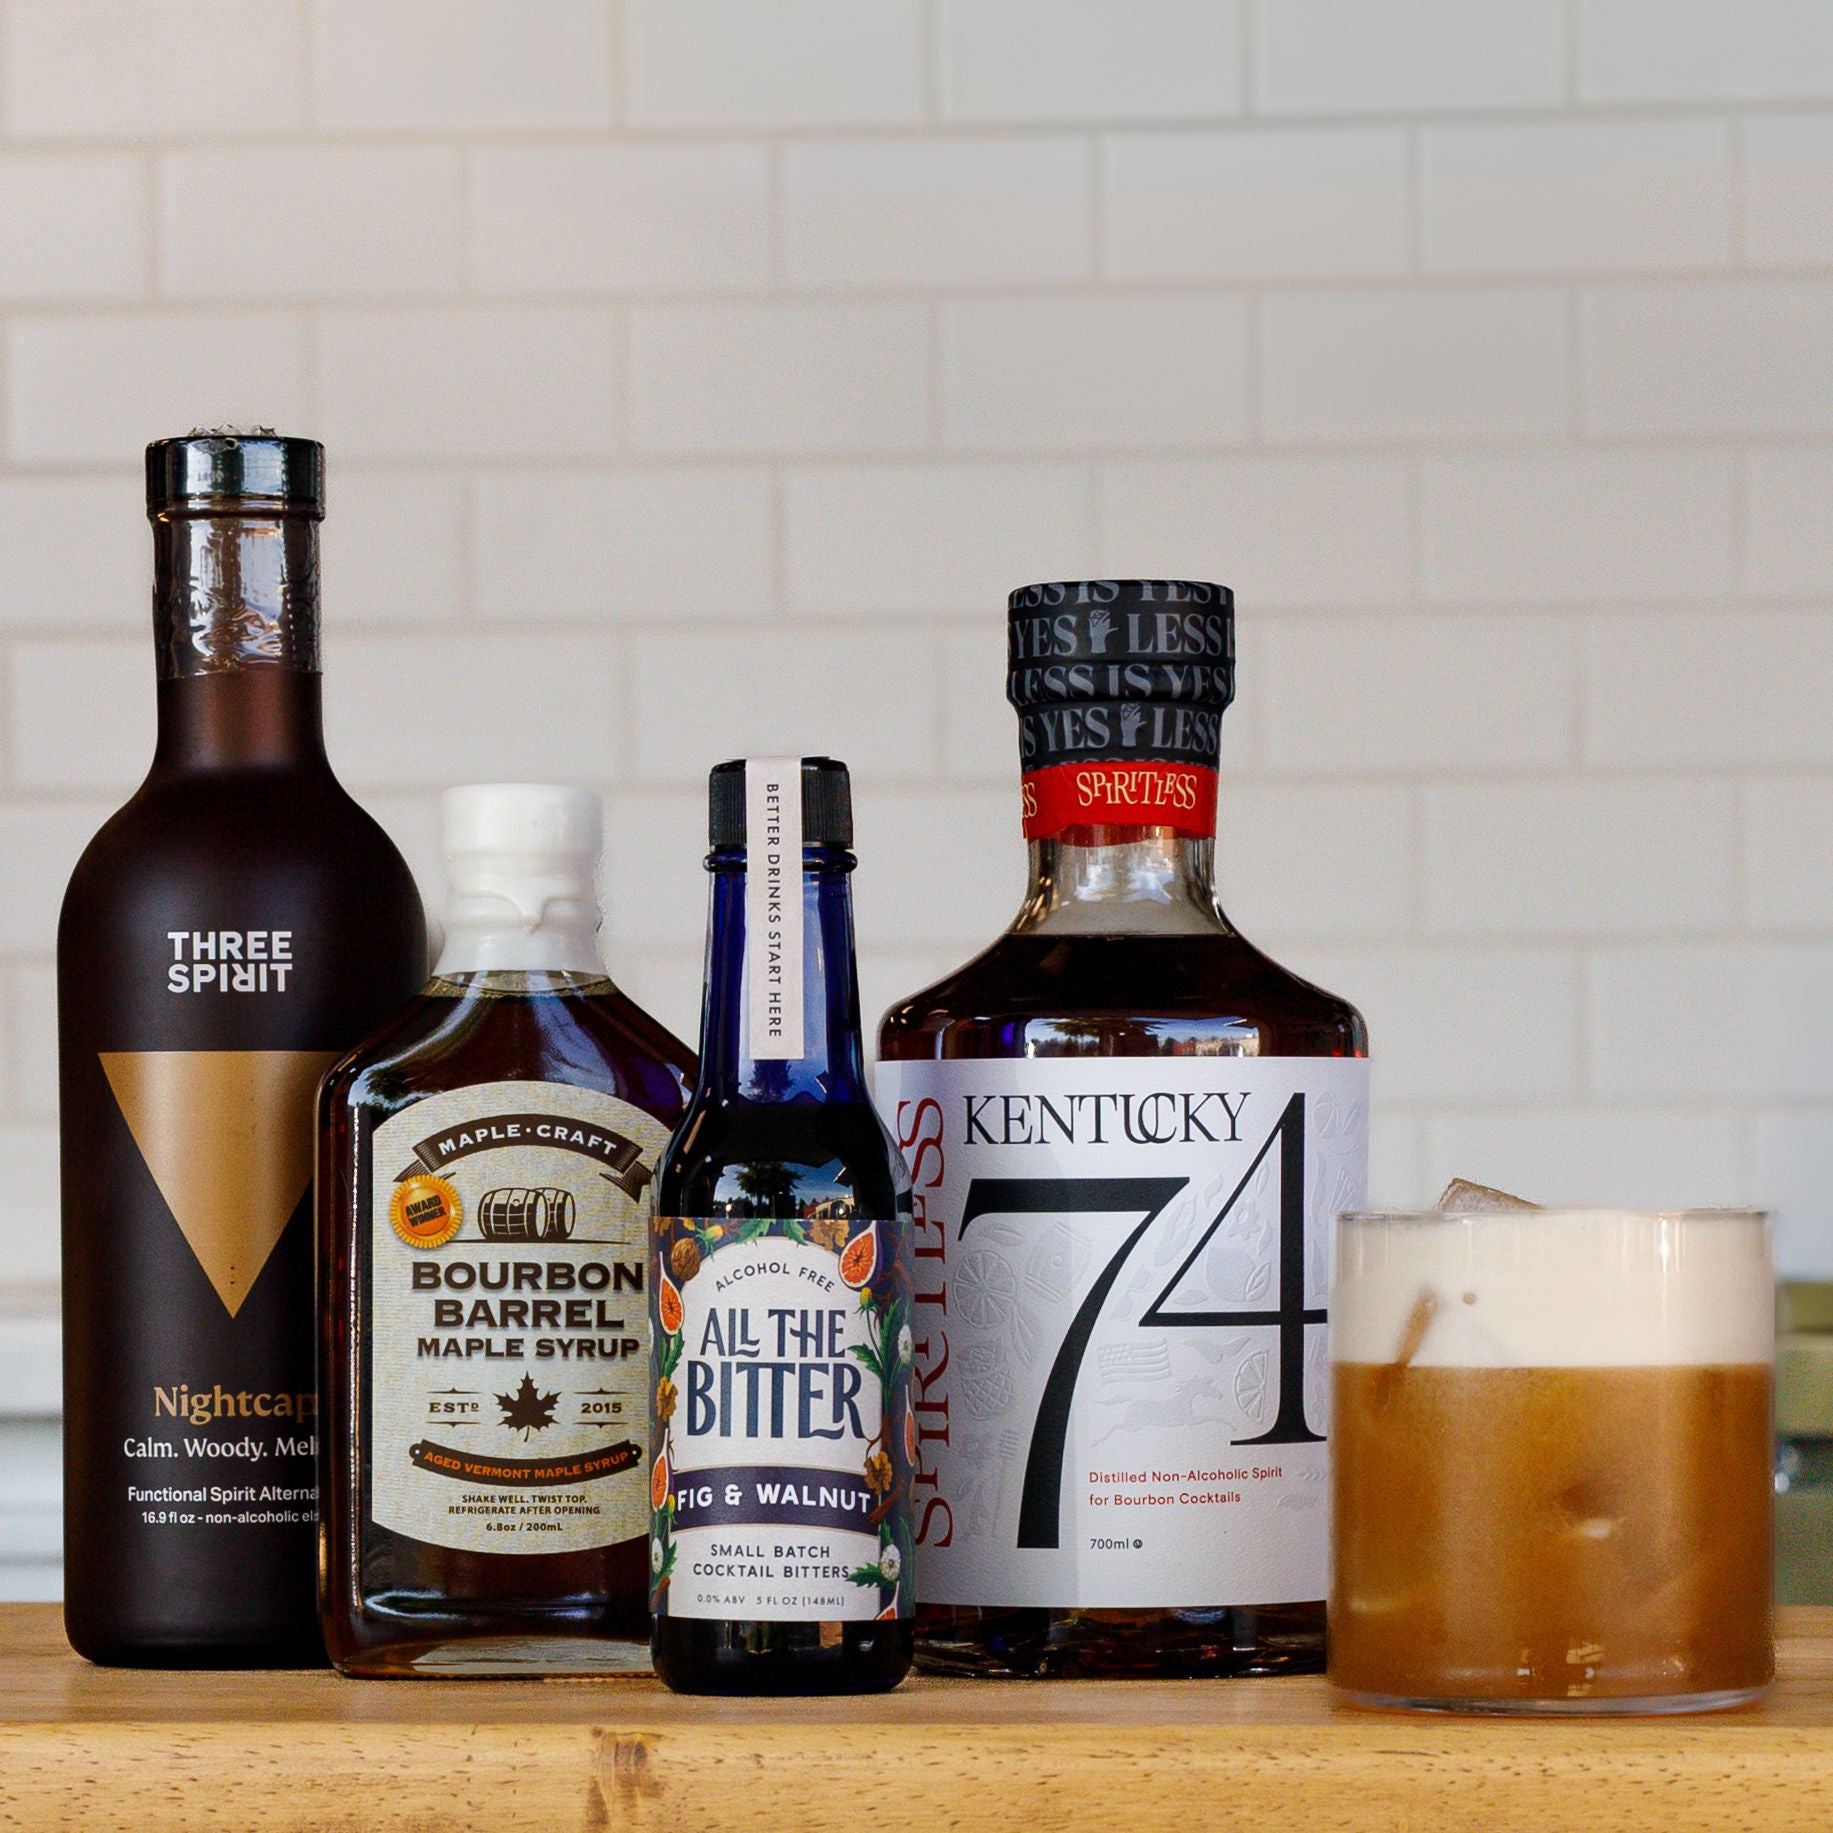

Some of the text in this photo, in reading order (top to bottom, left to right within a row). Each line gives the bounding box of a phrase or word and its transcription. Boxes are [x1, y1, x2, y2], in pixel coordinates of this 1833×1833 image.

[1012, 614, 1077, 660] YES
[1127, 613, 1222, 656] LESS
[1011, 664, 1227, 706] LESS IS YES
[1040, 707, 1110, 752] YES
[1152, 707, 1219, 756] LESS
[1076, 771, 1198, 810] SPIRITLESS
[766, 784, 782, 1037] BETTER DRINKS START HERE
[167, 931, 293, 960] THREE
[167, 963, 293, 993] SPIRIT
[963, 1092, 1252, 1145] KENTUCKY
[405, 1194, 442, 1217] AWARD
[408, 1206, 447, 1227] WINNER
[412, 1262, 644, 1291] BOURBON
[716, 1262, 835, 1293] ALCOHOL FREE
[434, 1299, 625, 1329] BARREL
[958, 1092, 1328, 1549] 74
[700, 1307, 846, 1358] ALL THE
[417, 1338, 640, 1358] MAPLE SYRUP
[581, 1402, 622, 1414] 2015
[687, 1360, 866, 1440] BITTER
[124, 1437, 178, 1458] Calm.
[184, 1437, 268, 1462] Woody.
[424, 1451, 629, 1479] AGED VERMONT MAPLE SYRUP
[1089, 1466, 1283, 1484] Distilled Non-Alcoholic Spirit
[128, 1486, 207, 1502] Functional
[210, 1486, 256, 1505] Spirit
[462, 1495, 588, 1504] SHAKE WELL. TWIST TOP.
[677, 1483, 871, 1513] FIG & WALNUT
[1089, 1491, 1241, 1506] for Bourbon Cocktails
[142, 1512, 166, 1524] 16.9
[169, 1511, 177, 1524] fl
[180, 1514, 195, 1524] oz
[206, 1510, 299, 1524] non-alcoholic
[449, 1506, 601, 1515] REFRIGERATE AFTER OPENING
[486, 1522, 516, 1532] 6.8oz
[526, 1522, 563, 1532] 200mL
[711, 1544, 830, 1558] SMALL BATCH
[1090, 1538, 1129, 1550] 700ml
[693, 1563, 849, 1579] COCKTAIL BITTERS
[697, 1594, 720, 1604] 0.0%
[724, 1595, 746, 1605] ABV
[756, 1596, 762, 1605] 5
[767, 1596, 777, 1605] FL
[782, 1596, 798, 1606] OZ
